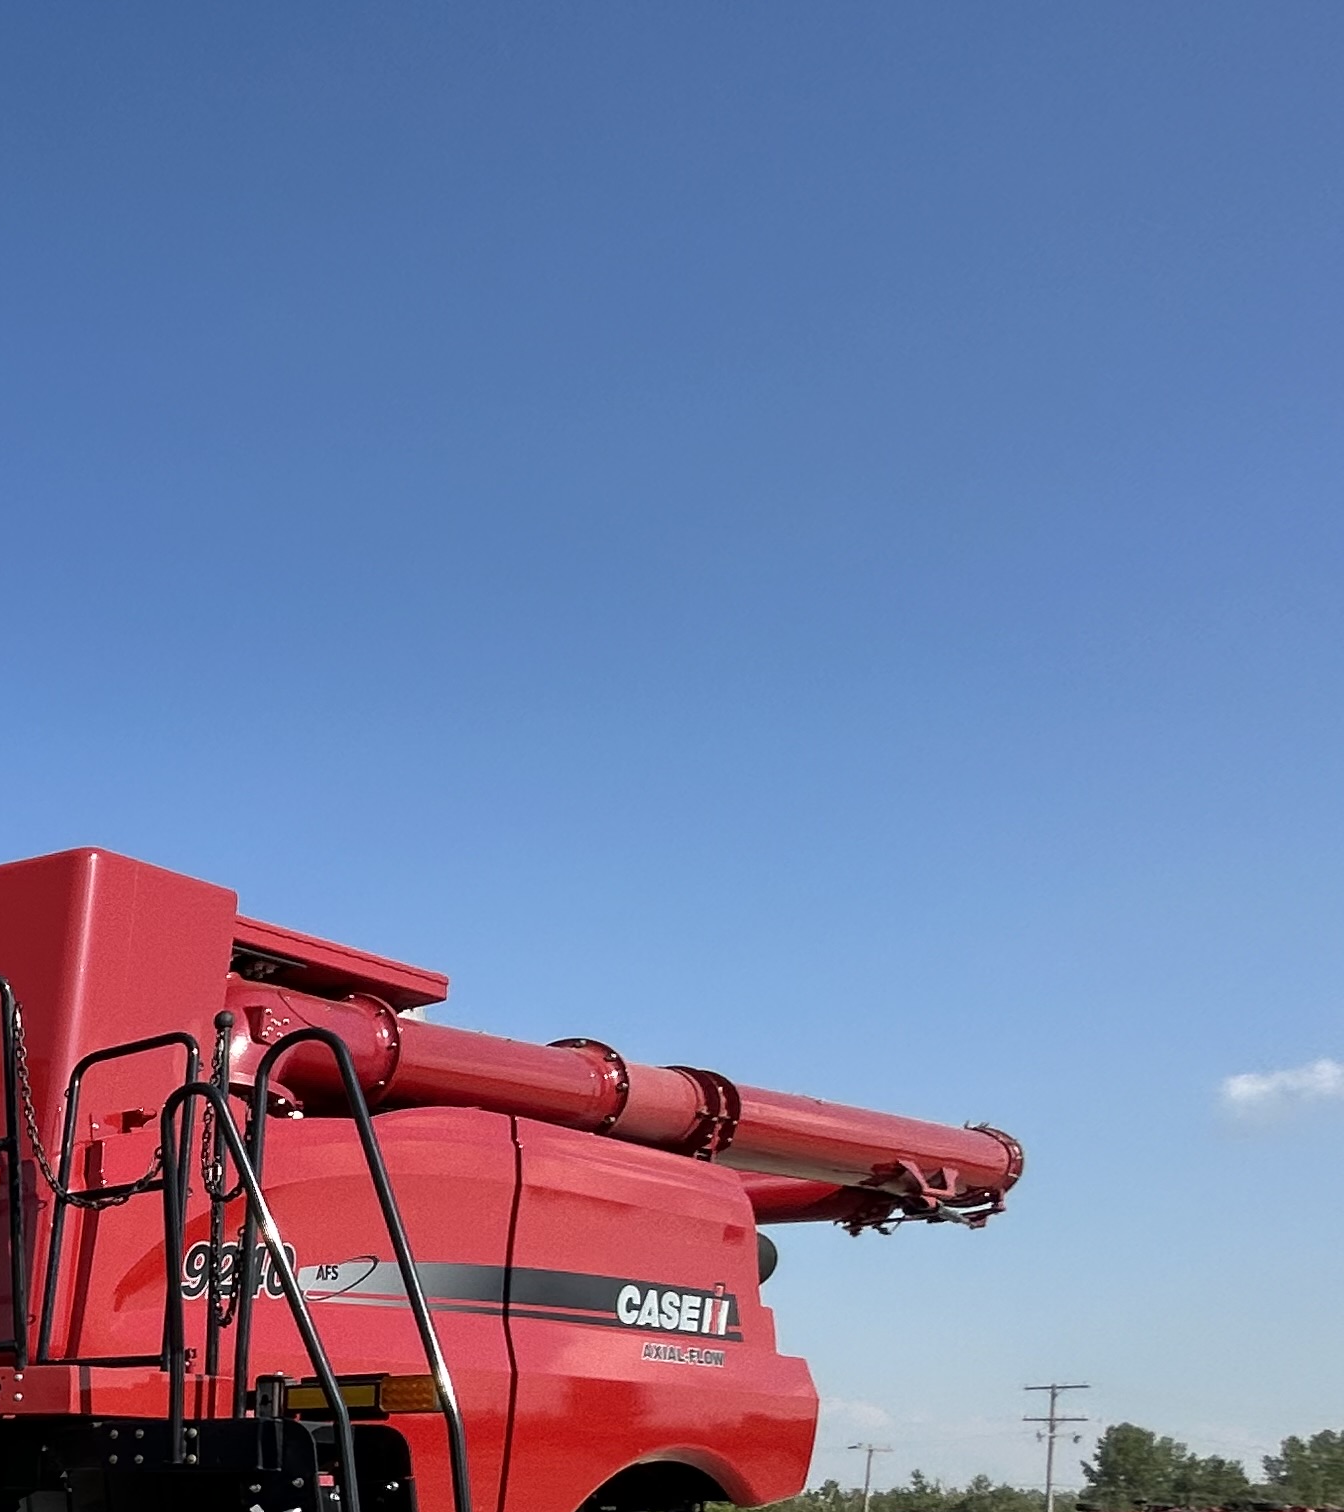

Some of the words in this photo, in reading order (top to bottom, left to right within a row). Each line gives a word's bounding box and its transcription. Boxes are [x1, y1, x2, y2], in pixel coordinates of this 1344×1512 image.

[315, 1265, 339, 1281] AFS
[616, 1284, 702, 1332] CASE
[642, 1342, 726, 1368] AXIAL-FLOW
